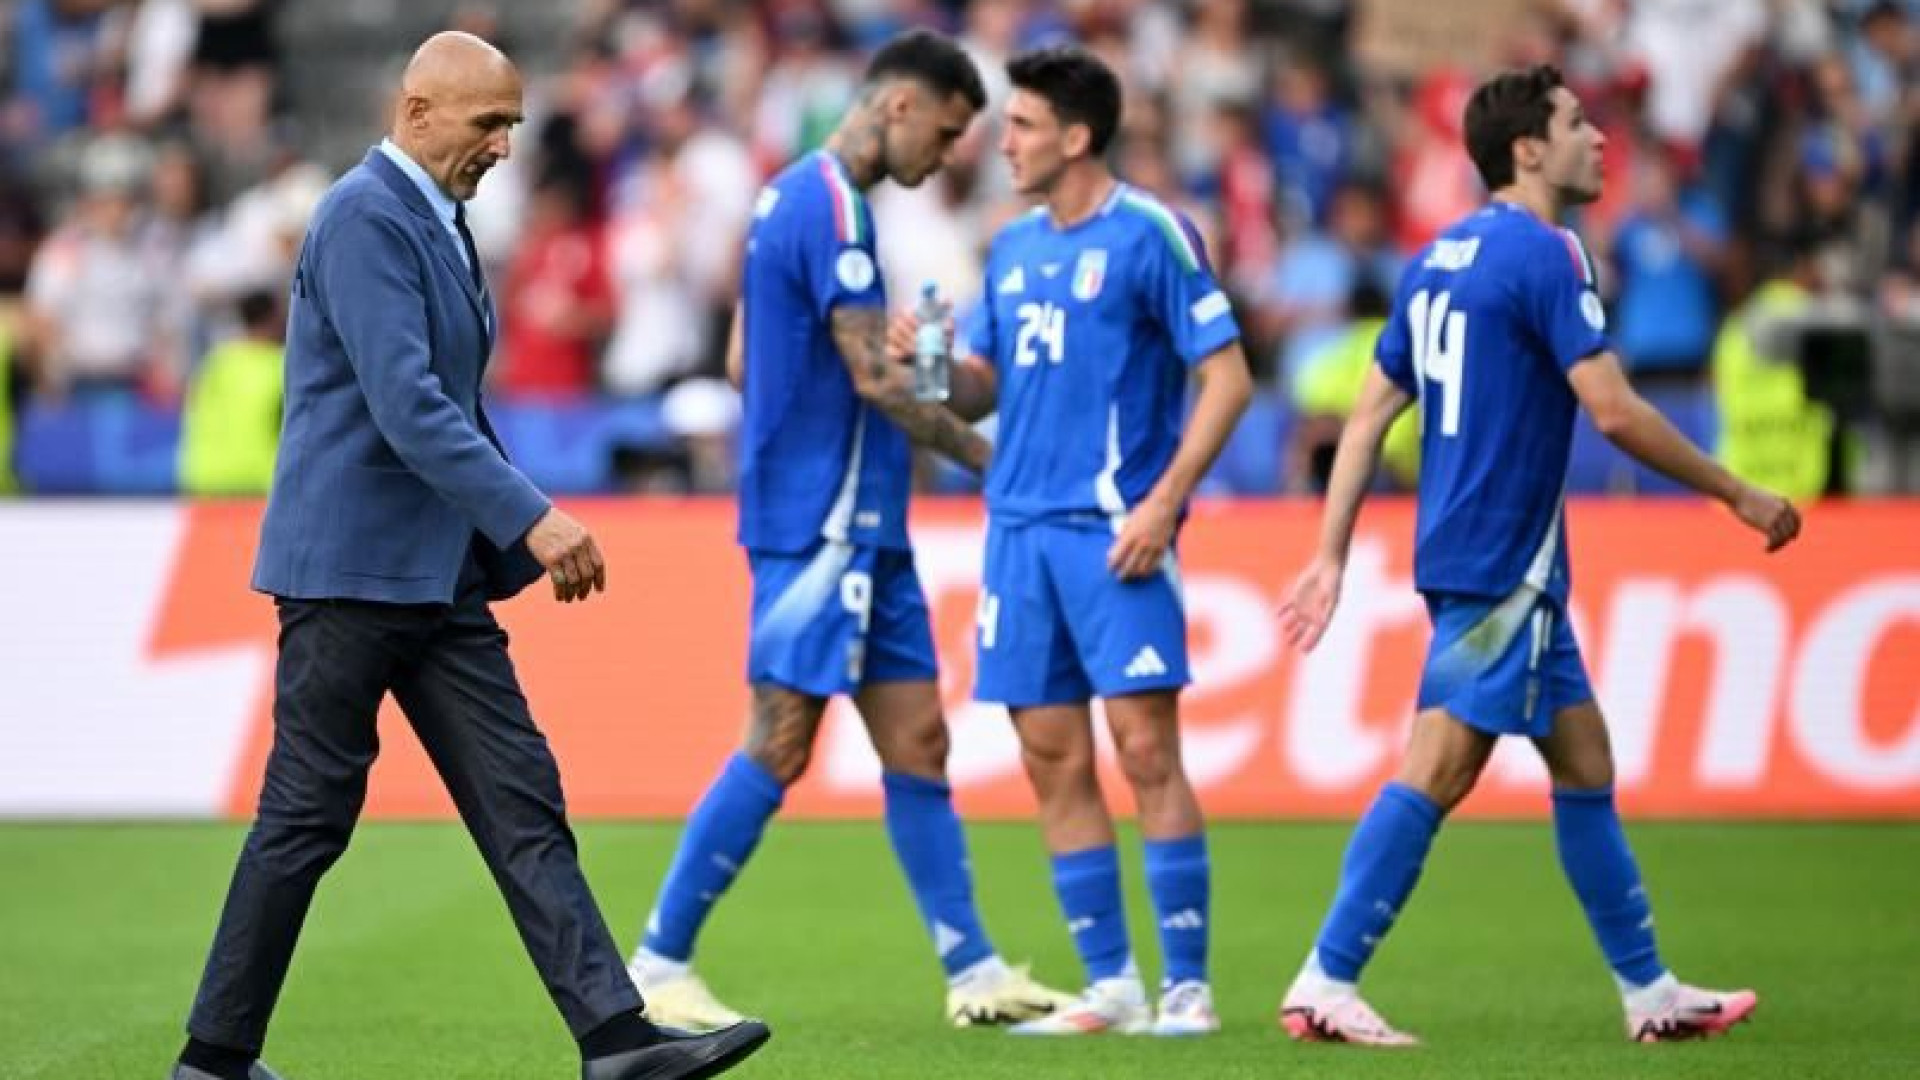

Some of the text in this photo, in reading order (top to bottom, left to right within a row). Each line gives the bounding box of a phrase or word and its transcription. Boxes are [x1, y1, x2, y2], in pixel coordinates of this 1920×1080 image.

[1016, 301, 1065, 367] 24
[1408, 288, 1467, 437] 14
[841, 571, 872, 623] 9
[820, 525, 1920, 793] etno
